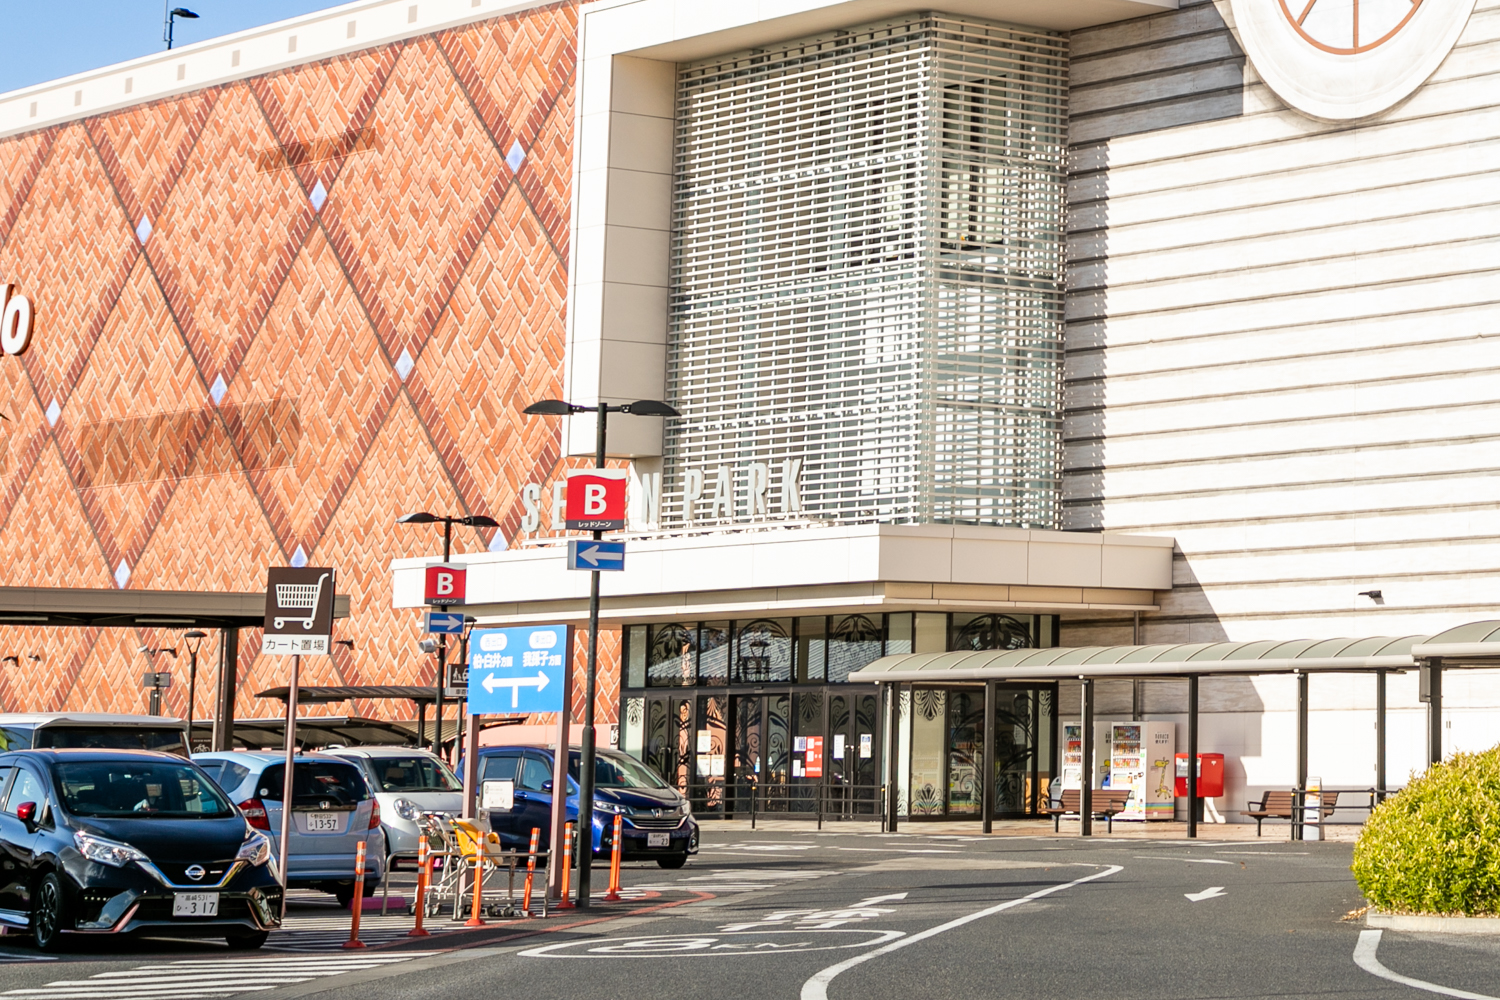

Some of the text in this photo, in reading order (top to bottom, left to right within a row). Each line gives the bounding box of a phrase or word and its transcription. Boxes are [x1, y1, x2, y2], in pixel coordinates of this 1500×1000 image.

[521, 458, 803, 533] SEN PARK
[584, 484, 607, 516] B
[577, 520, 612, 529] レッドゾーン
[437, 572, 454, 595] B
[265, 639, 325, 651] カート置場
[522, 650, 562, 667] 我孫子方面
[315, 819, 337, 829] 13-57
